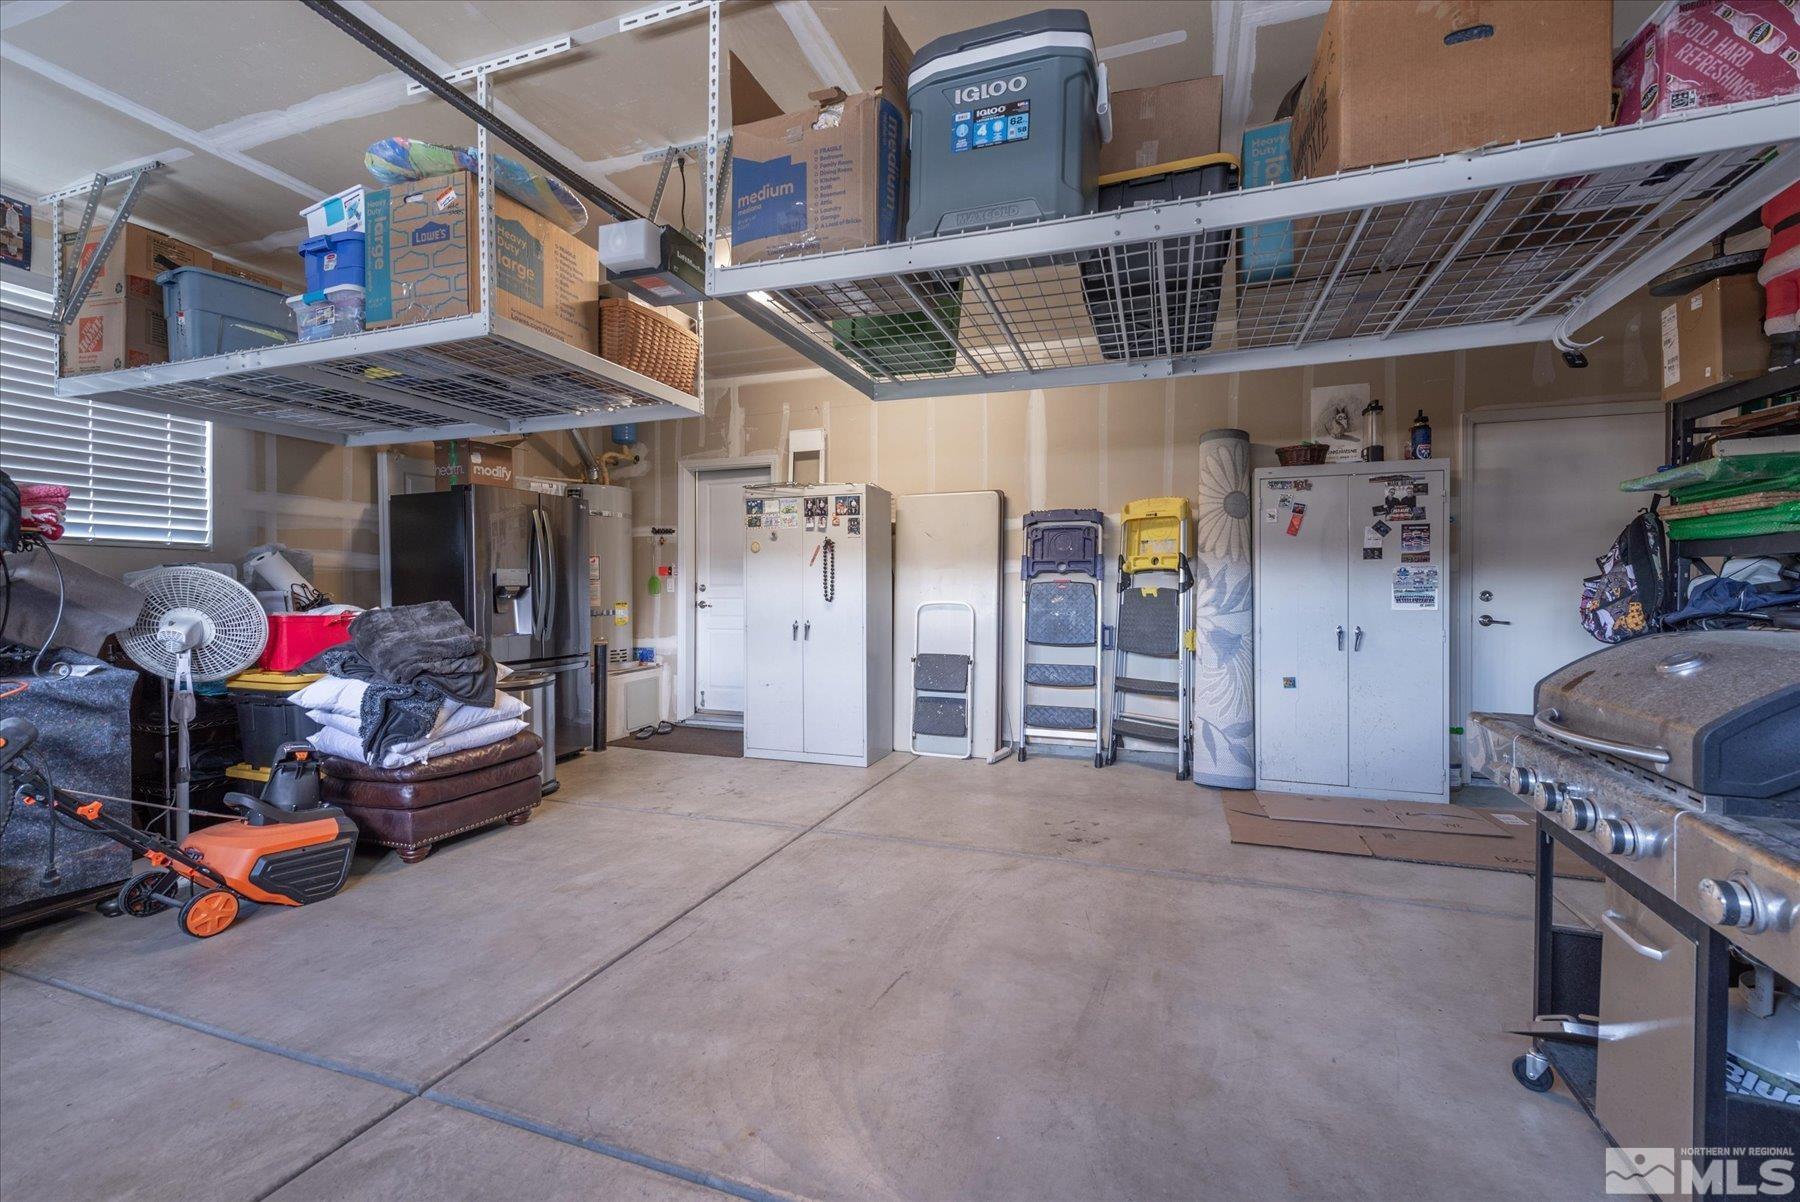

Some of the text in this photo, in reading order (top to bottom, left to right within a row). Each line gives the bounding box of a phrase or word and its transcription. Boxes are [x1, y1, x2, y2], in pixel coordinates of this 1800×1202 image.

[1680, 17, 1718, 48] COLD.
[1711, 36, 1754, 71] HARD.
[955, 76, 1028, 105] IGLOO
[976, 105, 1006, 117] IGLOO
[1010, 116, 1023, 126] 62
[976, 124, 987, 137] 4
[1252, 133, 1286, 148] Heavy
[1251, 145, 1277, 158] Duty
[738, 182, 794, 209] medium
[371, 216, 387, 270] large
[415, 228, 447, 244] LOWE'S
[497, 224, 528, 250] Heavy
[497, 236, 520, 256] Duty
[497, 249, 535, 281] large
[473, 465, 512, 482] modify
